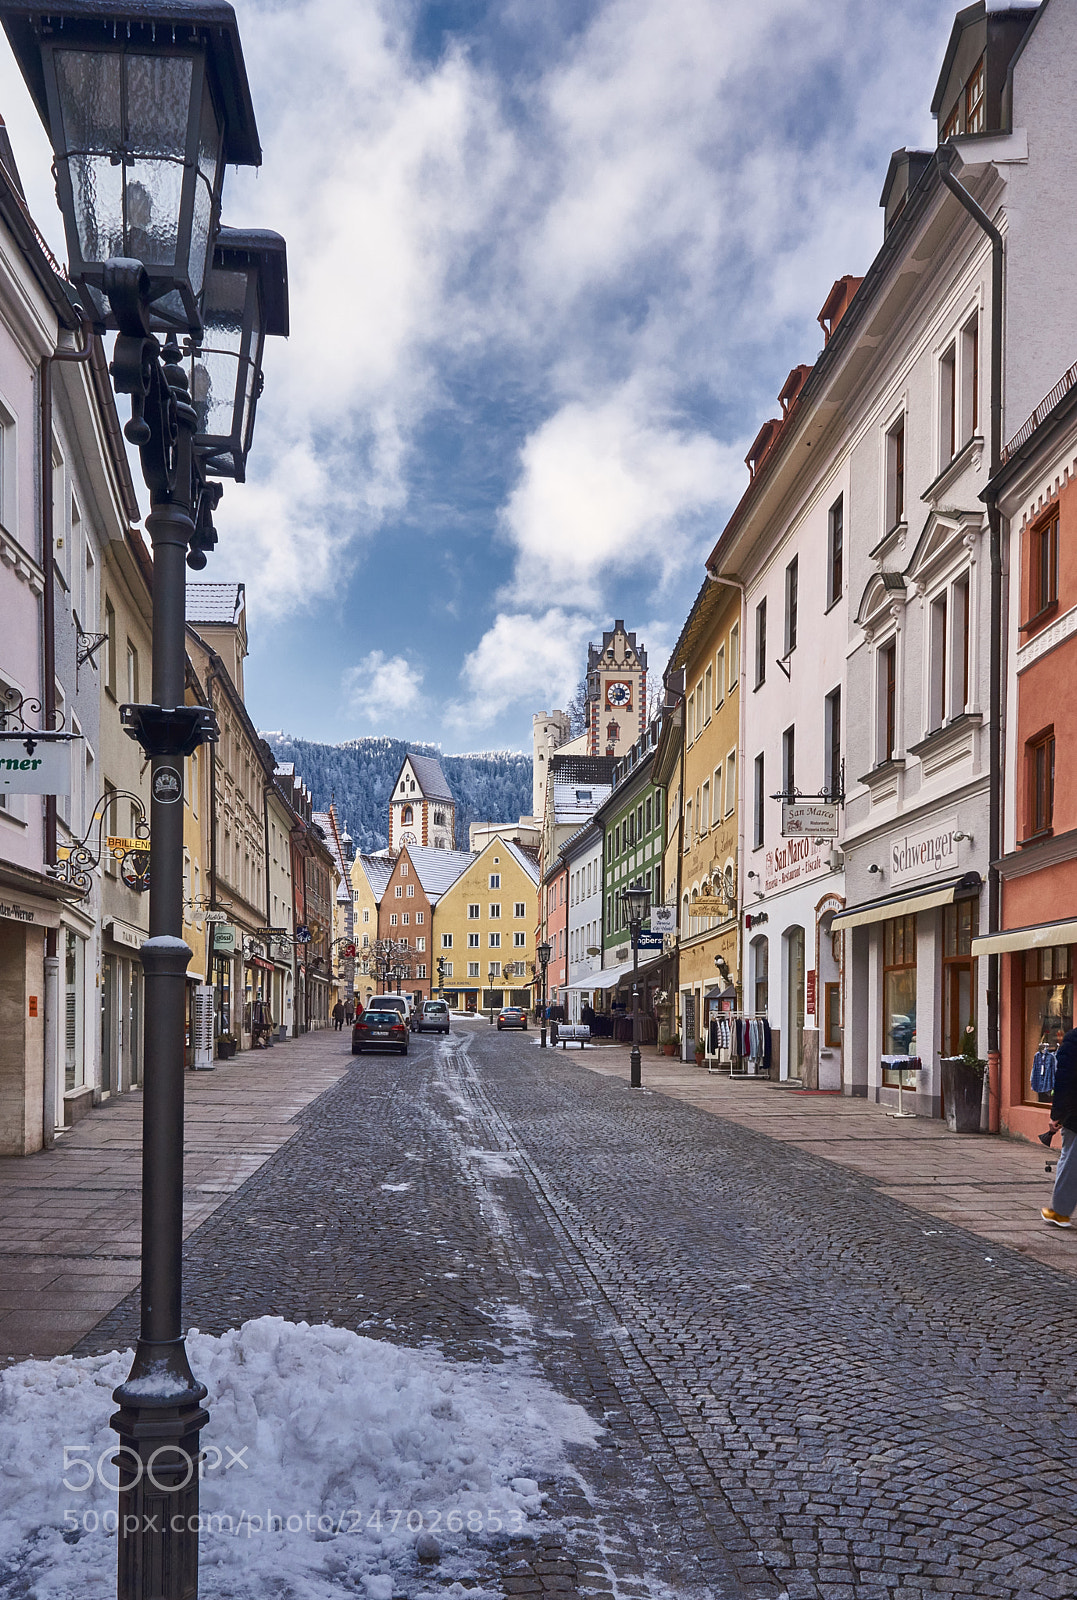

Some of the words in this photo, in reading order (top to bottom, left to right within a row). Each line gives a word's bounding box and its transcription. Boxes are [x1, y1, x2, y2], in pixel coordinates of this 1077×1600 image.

[789, 809, 804, 819] San
[806, 807, 834, 819] Marco
[108, 838, 150, 849] BRILLEN
[893, 830, 955, 873] Schwenger
[774, 847, 787, 872] San
[787, 837, 809, 866] Marco
[781, 865, 801, 884] Restaurant
[632, 932, 662, 946] ngbers
